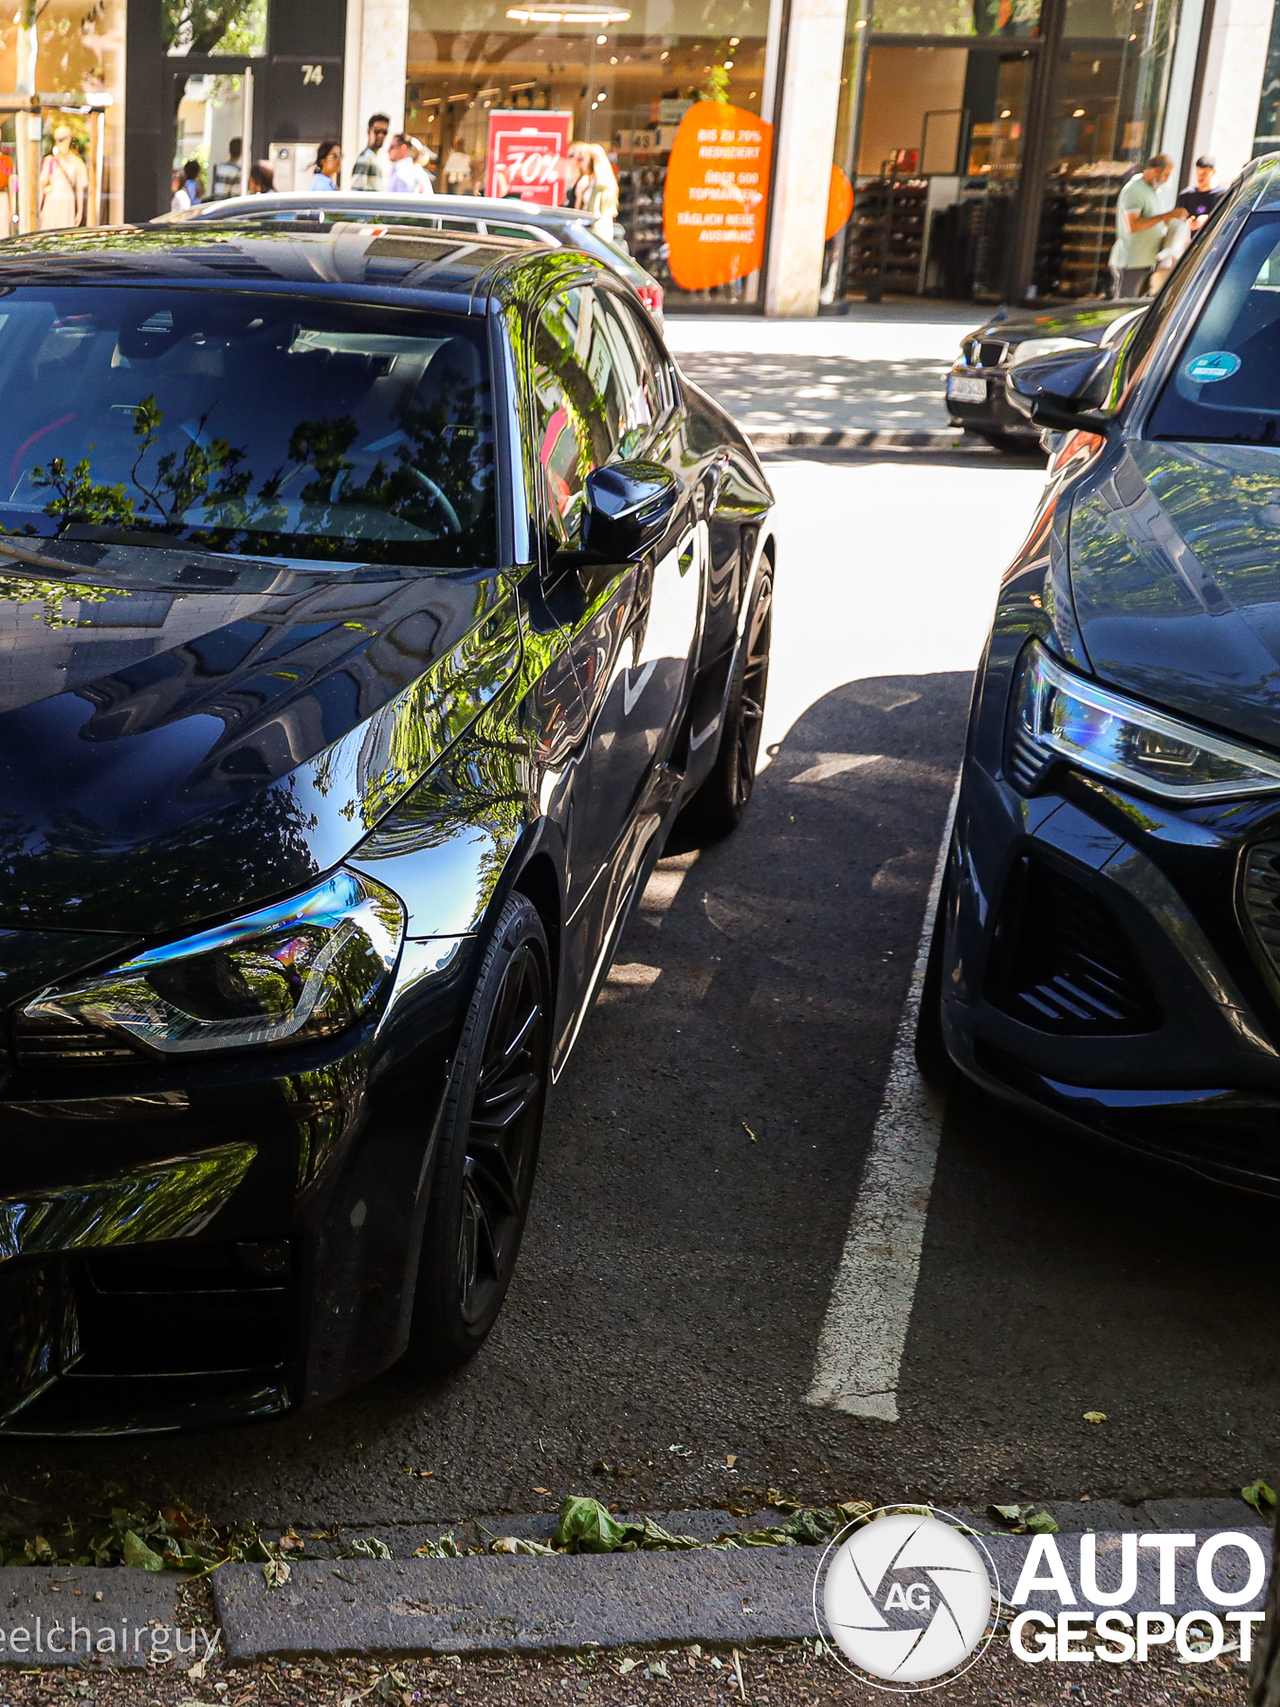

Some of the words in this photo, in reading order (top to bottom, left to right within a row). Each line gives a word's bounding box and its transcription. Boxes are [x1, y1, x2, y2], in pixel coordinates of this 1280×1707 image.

[301, 64, 324, 86] 74
[697, 128, 718, 143] BIS
[720, 129, 735, 143] ZU
[738, 130, 762, 143] 70%
[699, 145, 761, 159] REDUZIERT
[493, 151, 560, 185] -70%
[705, 169, 736, 185] ÜBER
[737, 172, 759, 185] 500
[677, 210, 725, 226] TÄGLICH
[725, 213, 756, 227] NEUE
[1207, 355, 1223, 368] 4
